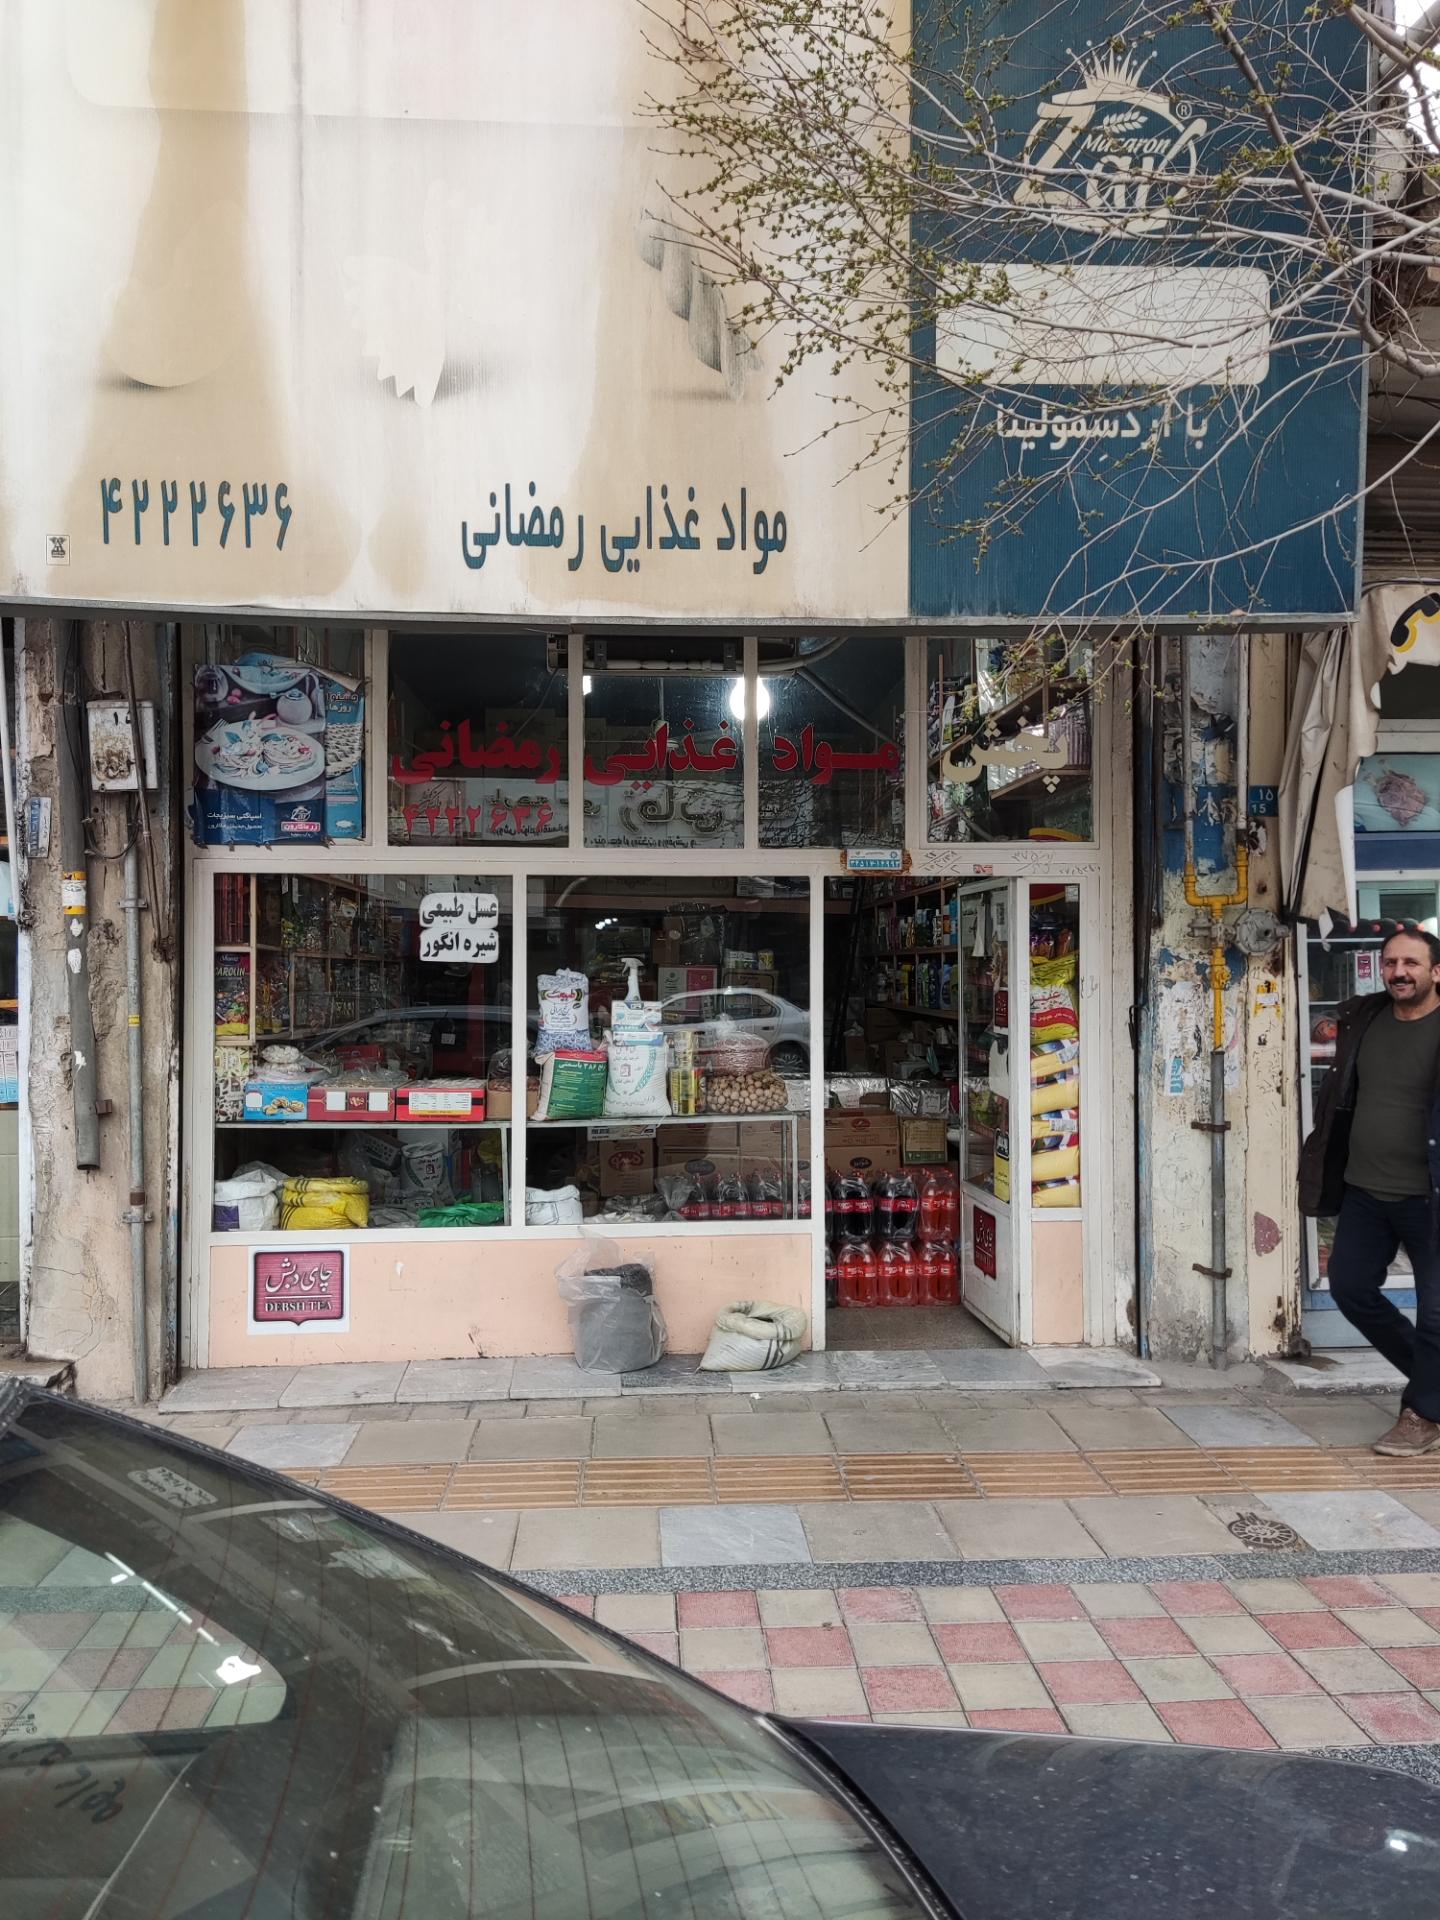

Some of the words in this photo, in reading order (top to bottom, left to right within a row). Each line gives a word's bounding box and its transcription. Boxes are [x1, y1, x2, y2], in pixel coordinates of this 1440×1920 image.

[1186, 404, 1208, 450] با
[100, 477, 293, 551] ۴۲۲۲۶۳۶
[461, 480, 584, 572] رمضانی
[600, 483, 701, 573] غذایی
[716, 486, 787, 574] مواد
[391, 719, 562, 785] رمضانی
[584, 718, 738, 792] غذایی
[772, 722, 899, 786] مواد
[942, 715, 1069, 794] پخش
[1251, 803, 1266, 814] 15
[1259, 788, 1274, 801] ۱۵
[402, 803, 554, 838] ۴۲۲۲۶۳۶
[422, 896, 465, 924] طبیعی
[468, 896, 498, 925] عسل
[422, 931, 460, 957] انگور
[464, 932, 497, 958] شیره
[265, 1257, 300, 1293] دبش
[300, 1263, 333, 1293] چای
[265, 1302, 305, 1312] DEBSH
[308, 1301, 333, 1311] TEA
